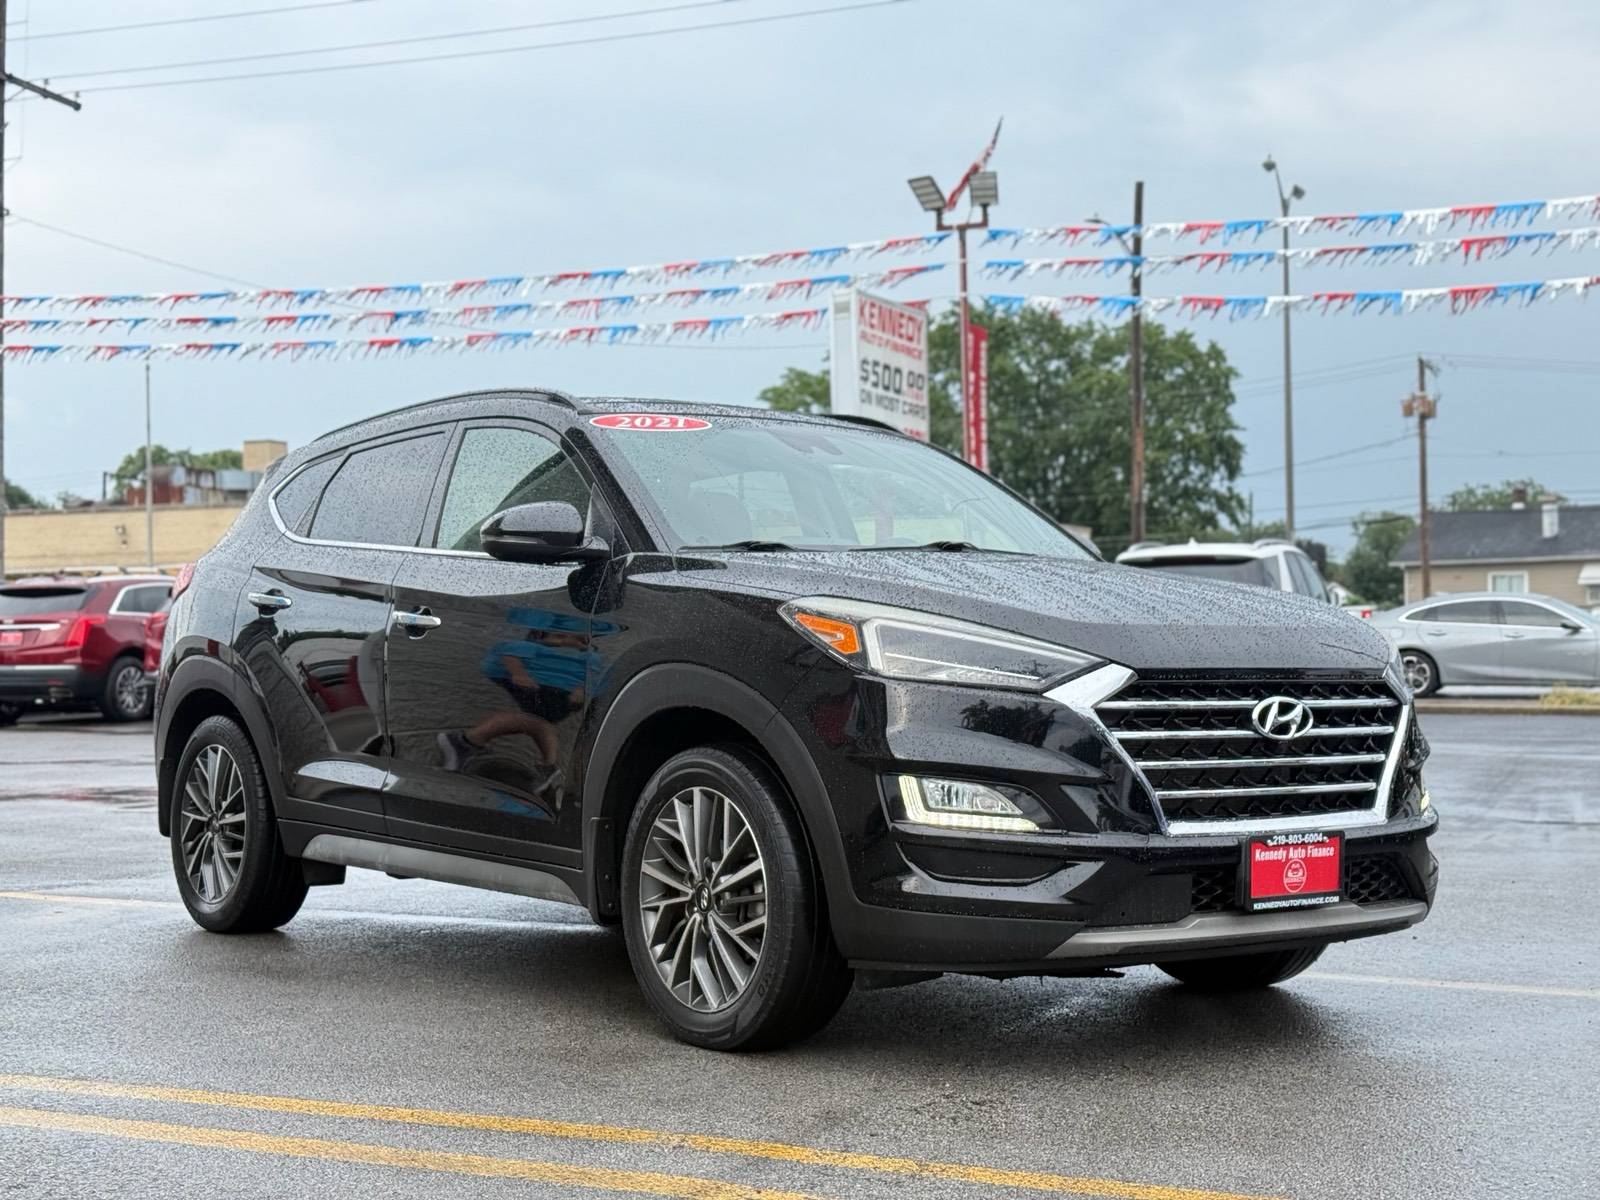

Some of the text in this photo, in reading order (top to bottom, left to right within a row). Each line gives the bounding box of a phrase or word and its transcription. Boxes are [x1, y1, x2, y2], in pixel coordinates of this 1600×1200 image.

[859, 298, 924, 345] KENNEDY
[616, 416, 687, 428] 2021
[1255, 846, 1335, 862] Kennedy Auto Finance
[1253, 896, 1340, 910] KENNEDYAUTOFINANCE.COM
